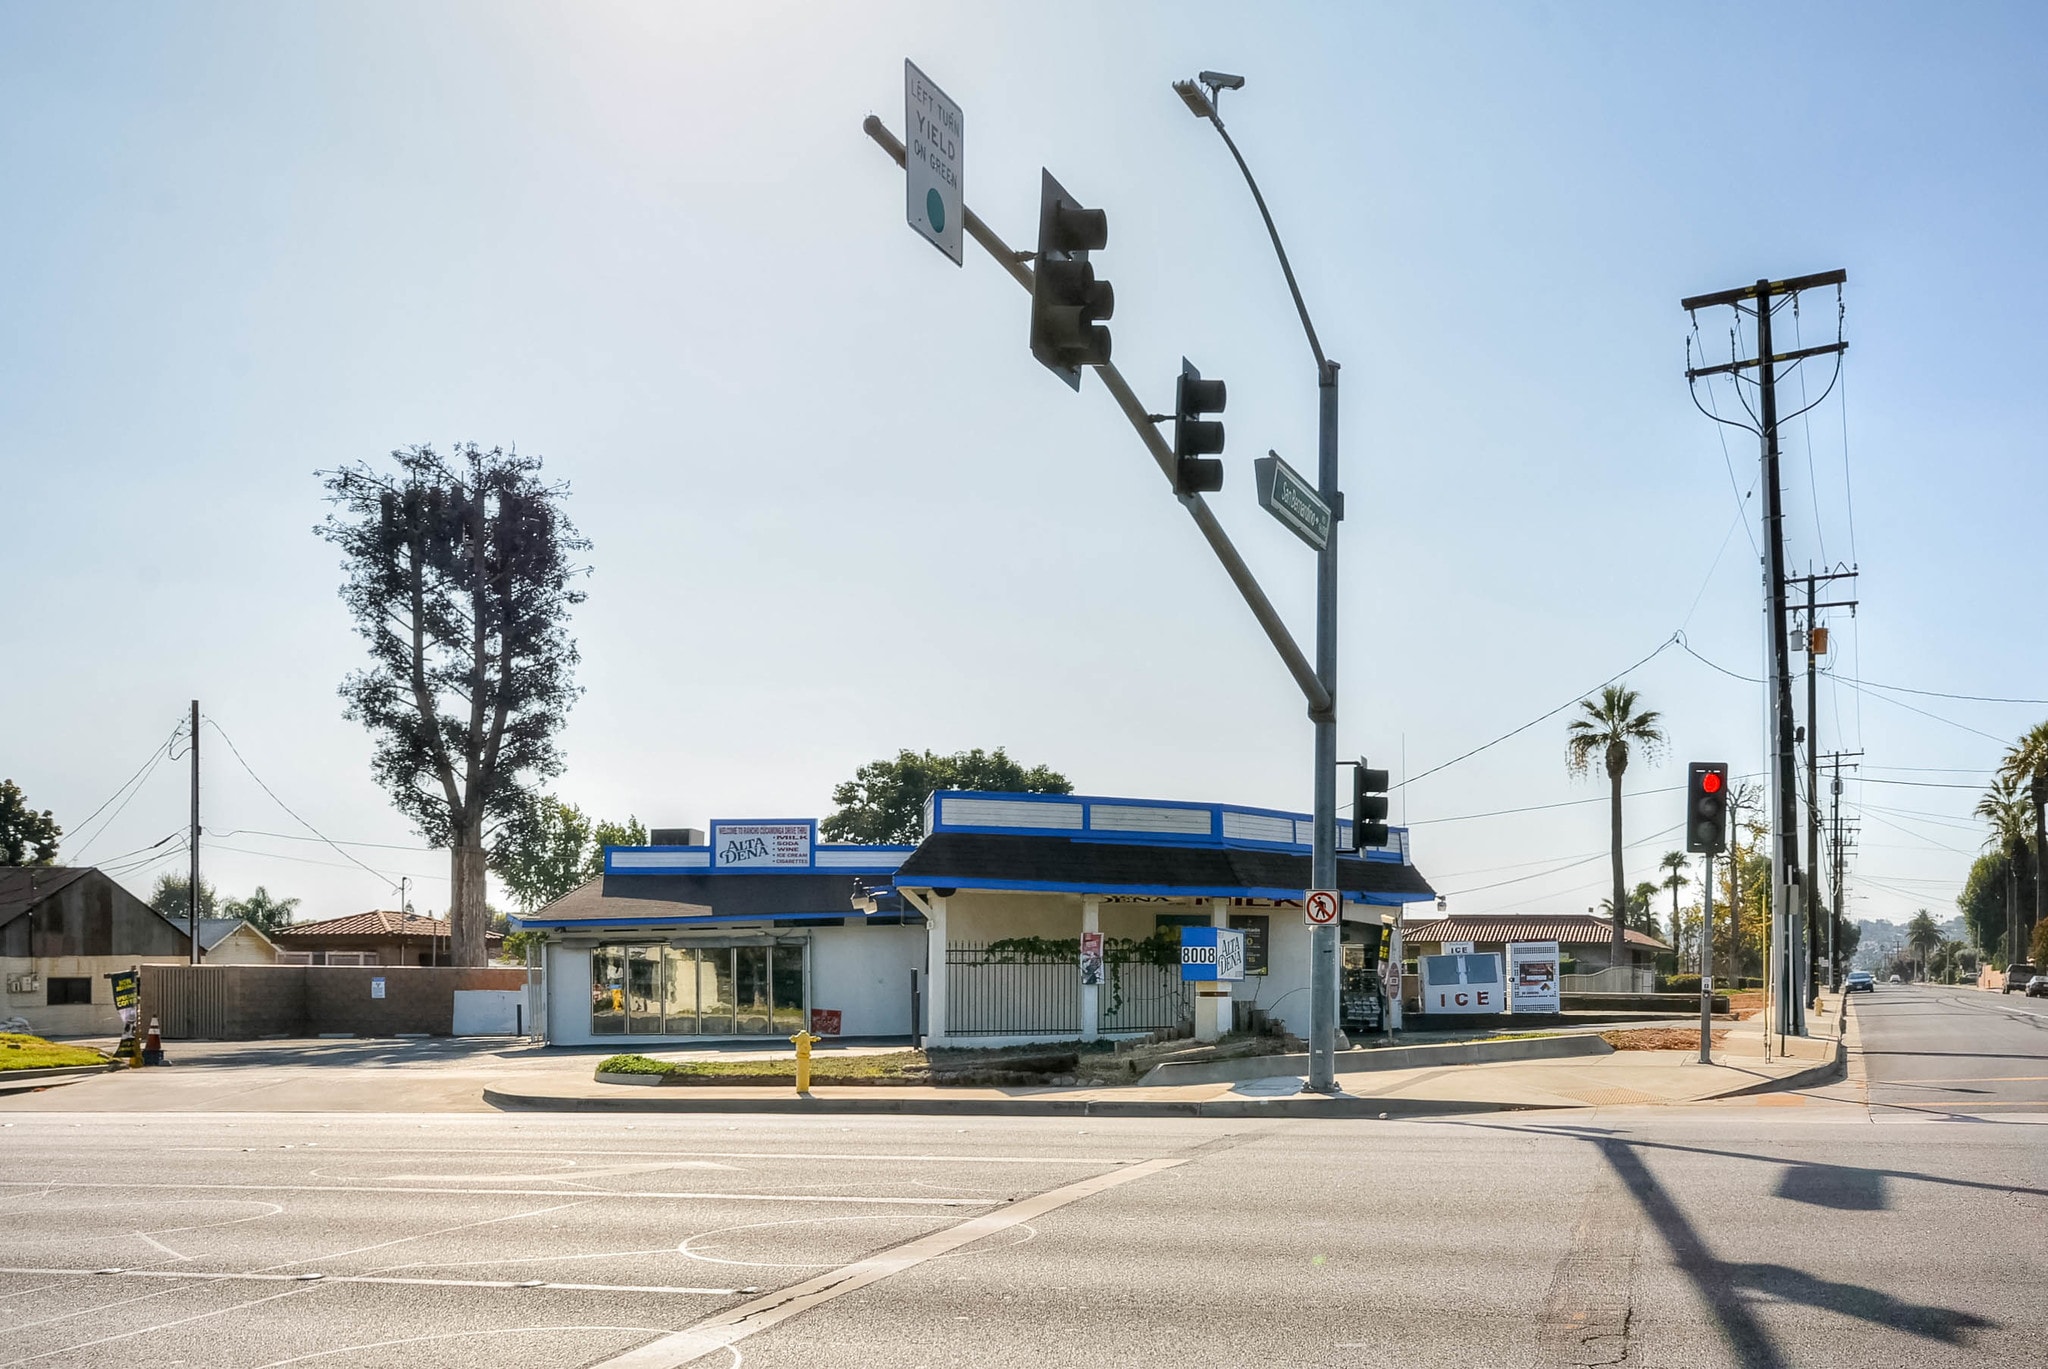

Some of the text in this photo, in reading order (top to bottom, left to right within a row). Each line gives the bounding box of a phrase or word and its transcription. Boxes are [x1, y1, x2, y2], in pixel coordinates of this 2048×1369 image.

[911, 79, 960, 138] LEFT TURN
[917, 110, 956, 161] YIELD
[914, 139, 958, 190] ON GREEN
[719, 846, 769, 864] DENA
[727, 837, 765, 853] ALTA
[1183, 948, 1216, 963] 8008
[1222, 936, 1241, 956] ALTA
[1218, 951, 1242, 976] DENA
[1441, 992, 1490, 1007] ICE
